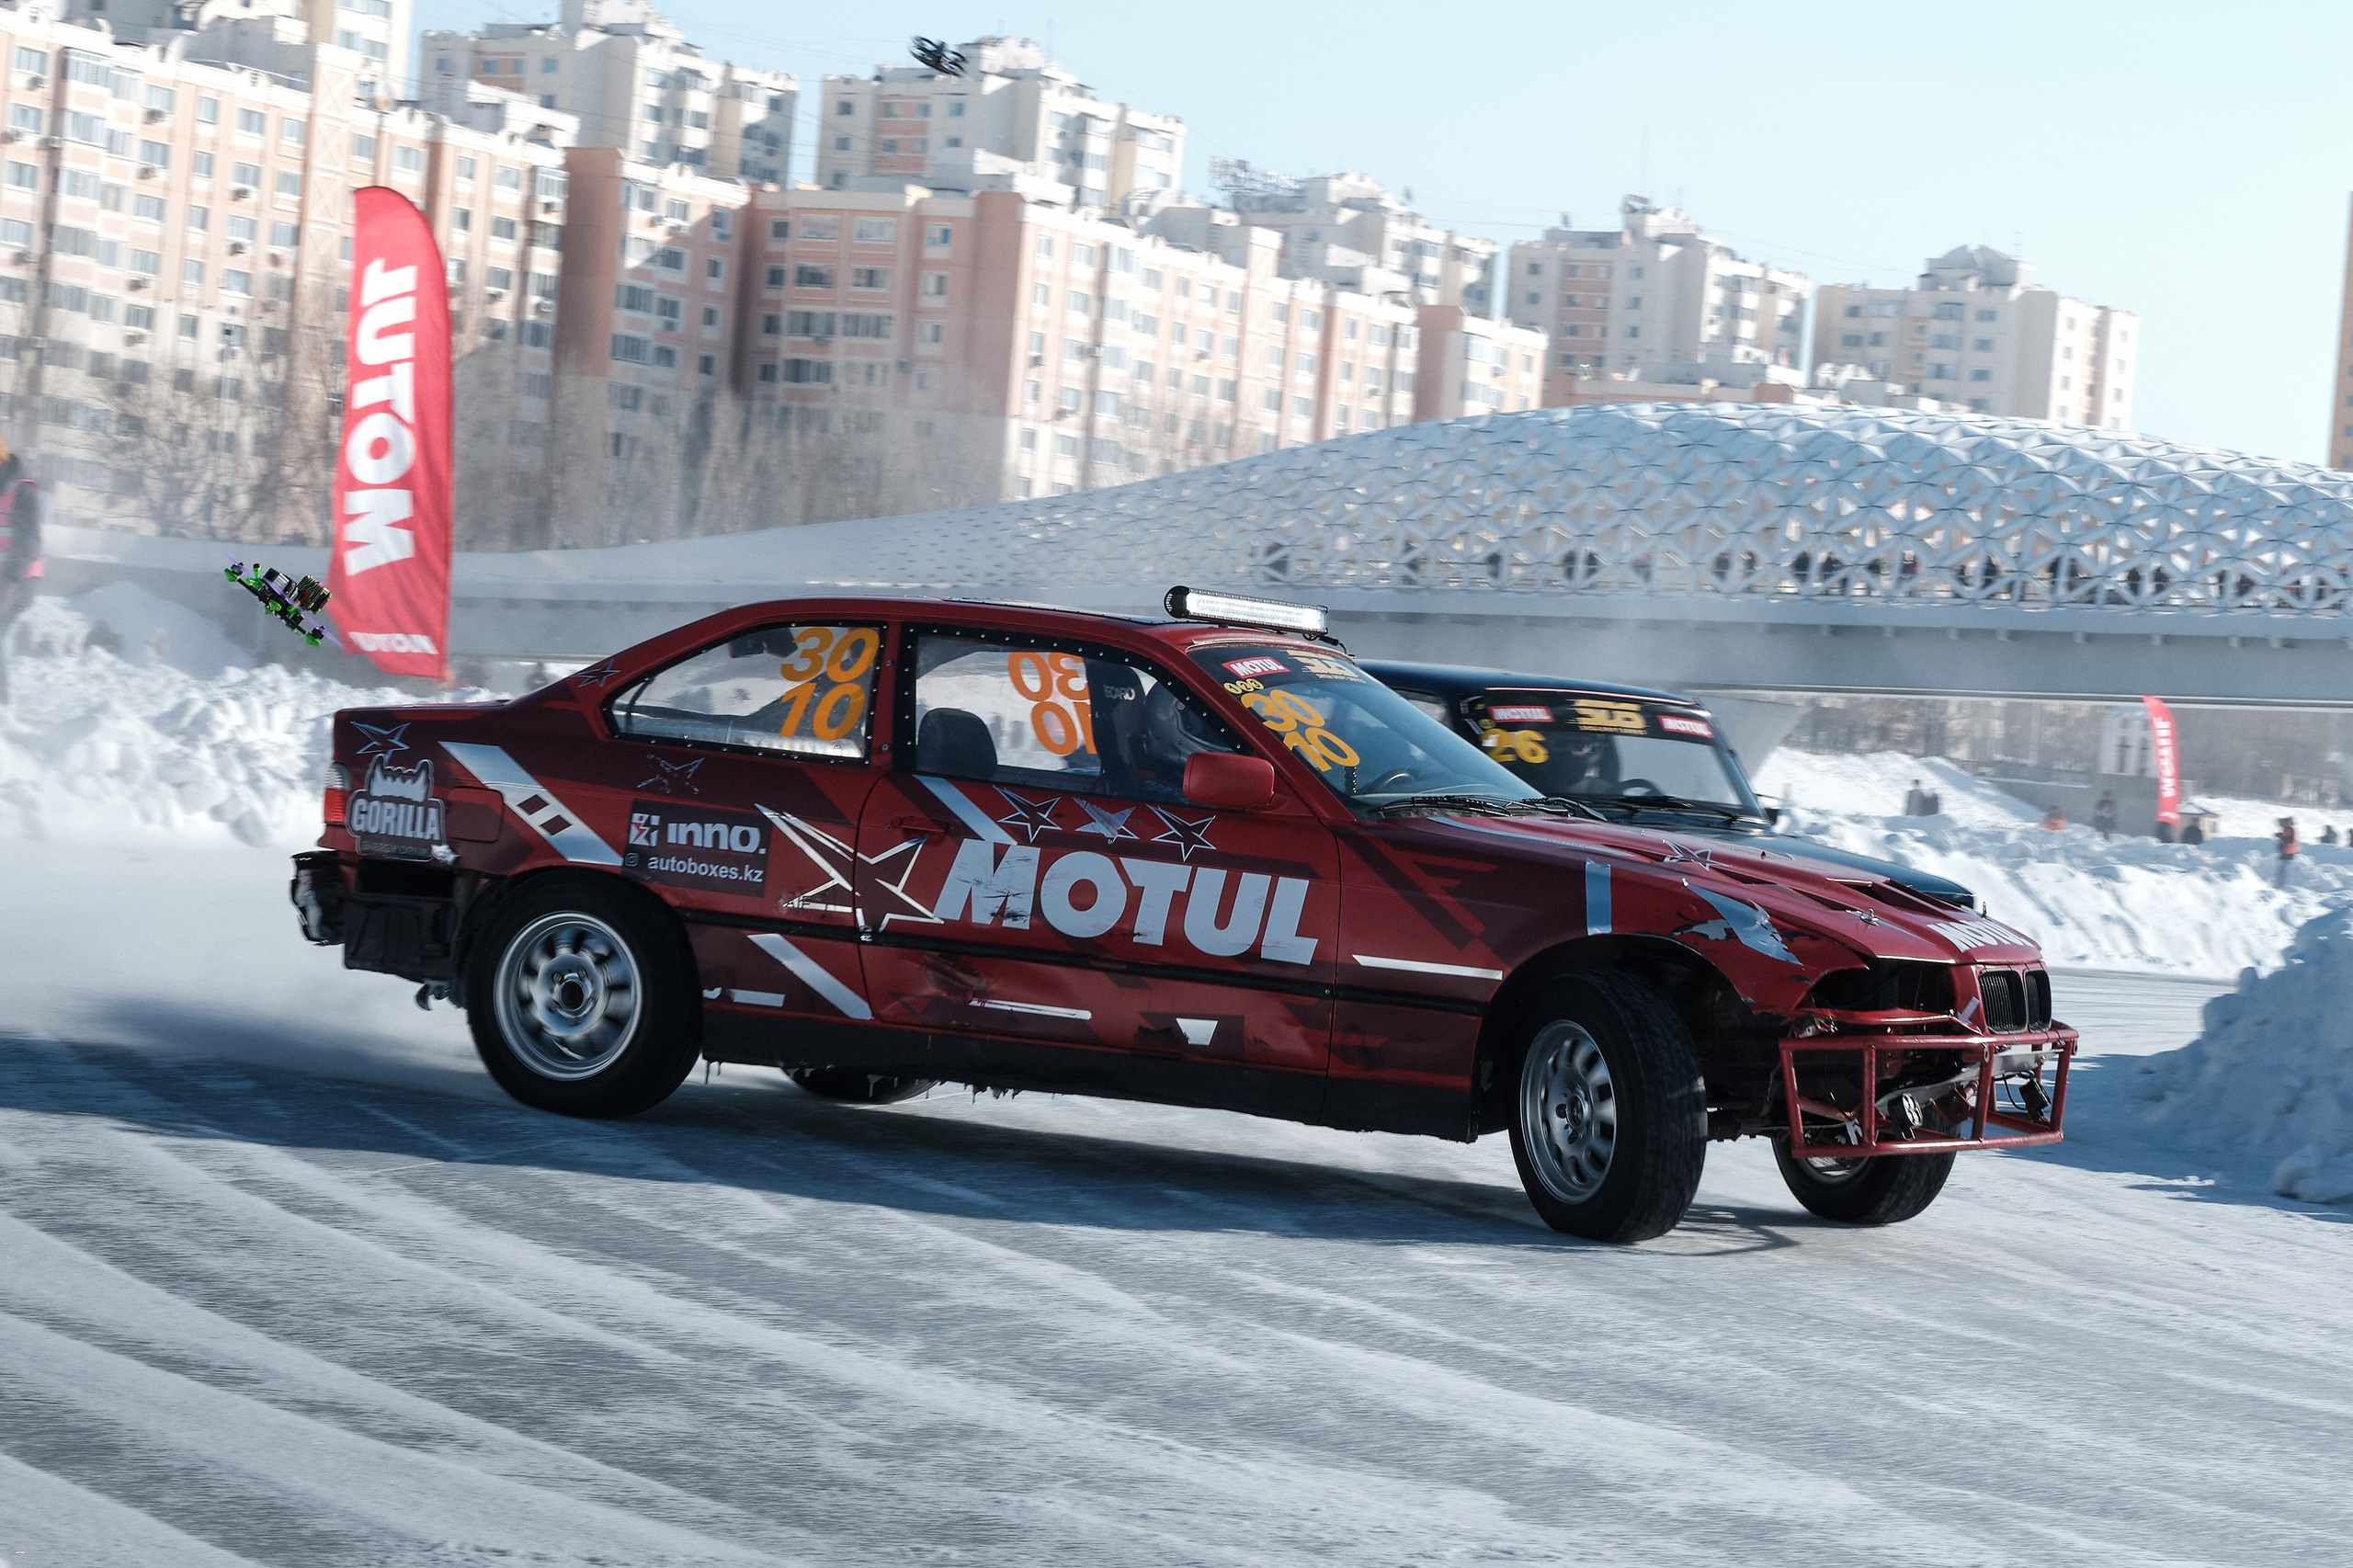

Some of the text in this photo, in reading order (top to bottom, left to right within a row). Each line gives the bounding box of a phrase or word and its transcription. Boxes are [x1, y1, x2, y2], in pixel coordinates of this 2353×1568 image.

[779, 627, 880, 683] 30
[1229, 658, 1286, 676] MOTUL
[778, 682, 866, 741] 10
[1240, 689, 1325, 733] 30
[1283, 726, 1360, 772] 10
[1479, 728, 1550, 764] 26
[351, 798, 441, 841] GORILLA
[647, 856, 764, 882] autoboxes.kz
[933, 838, 1318, 965] MOTUL
